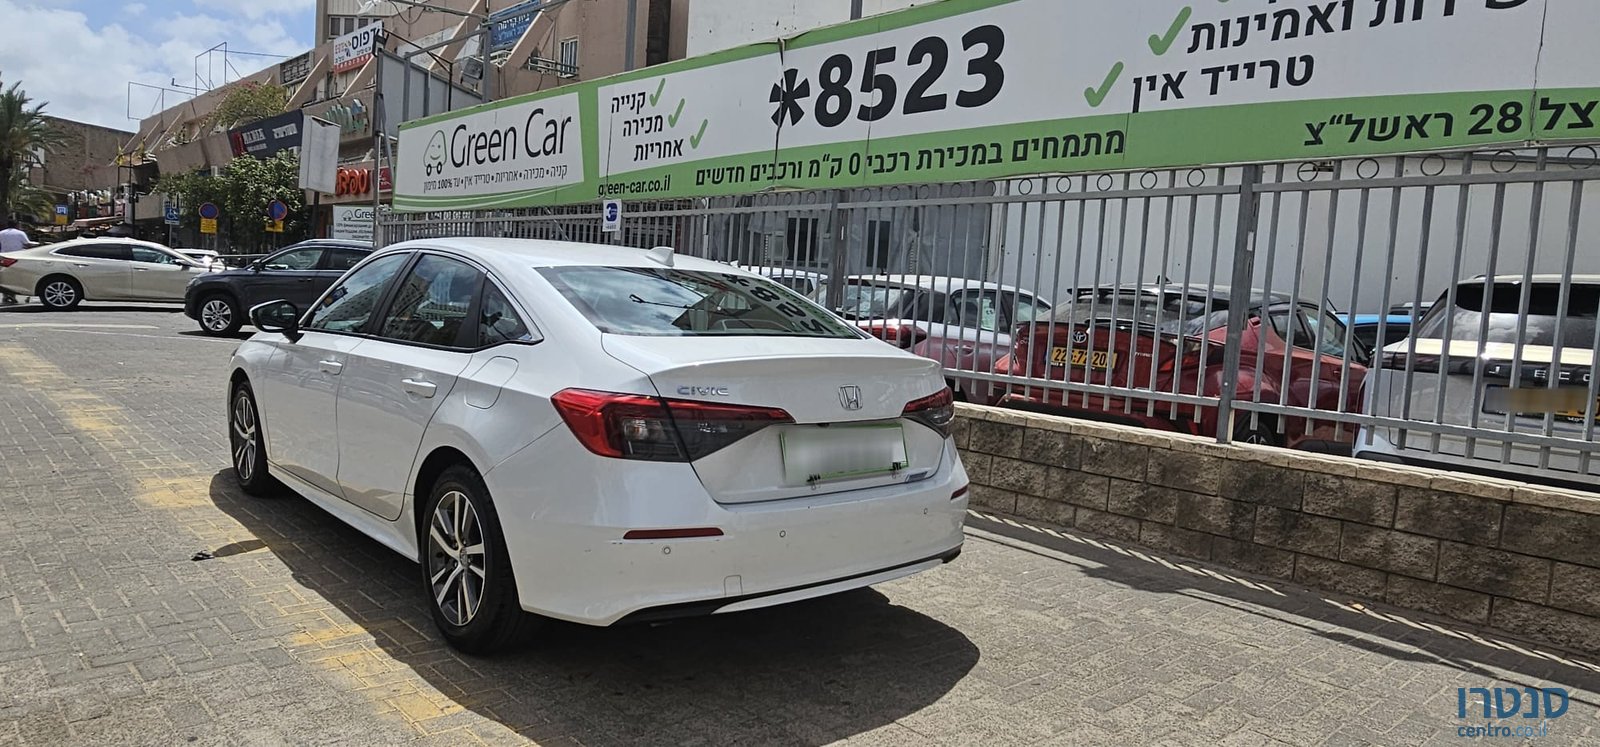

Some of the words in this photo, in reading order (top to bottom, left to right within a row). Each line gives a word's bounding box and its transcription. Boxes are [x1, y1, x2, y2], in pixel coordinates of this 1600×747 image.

[1187, 0, 1354, 54] ואמינות
[1200, 54, 1315, 96] טרייד
[611, 91, 646, 115] קנייה
[1132, 70, 1188, 114] אין
[623, 114, 663, 137] מכירה
[1467, 101, 1524, 136] 28
[450, 123, 517, 168] Green
[524, 107, 572, 158] Car
[1011, 129, 1125, 162] מתמחים
[633, 138, 684, 162] אחריות
[915, 142, 1003, 171] במכירת
[523, 167, 545, 180] מכירה
[550, 164, 568, 180] קניה
[750, 160, 803, 182] ורכבים
[848, 152, 861, 176] 0
[867, 151, 910, 174] רכבי
[437, 178, 453, 190] 100%
[474, 173, 491, 185] טרייד
[494, 170, 519, 183] אחריות
[695, 165, 745, 186] חדשים
[354, 208, 375, 219] Gree
[676, 385, 730, 397] CIVIC
